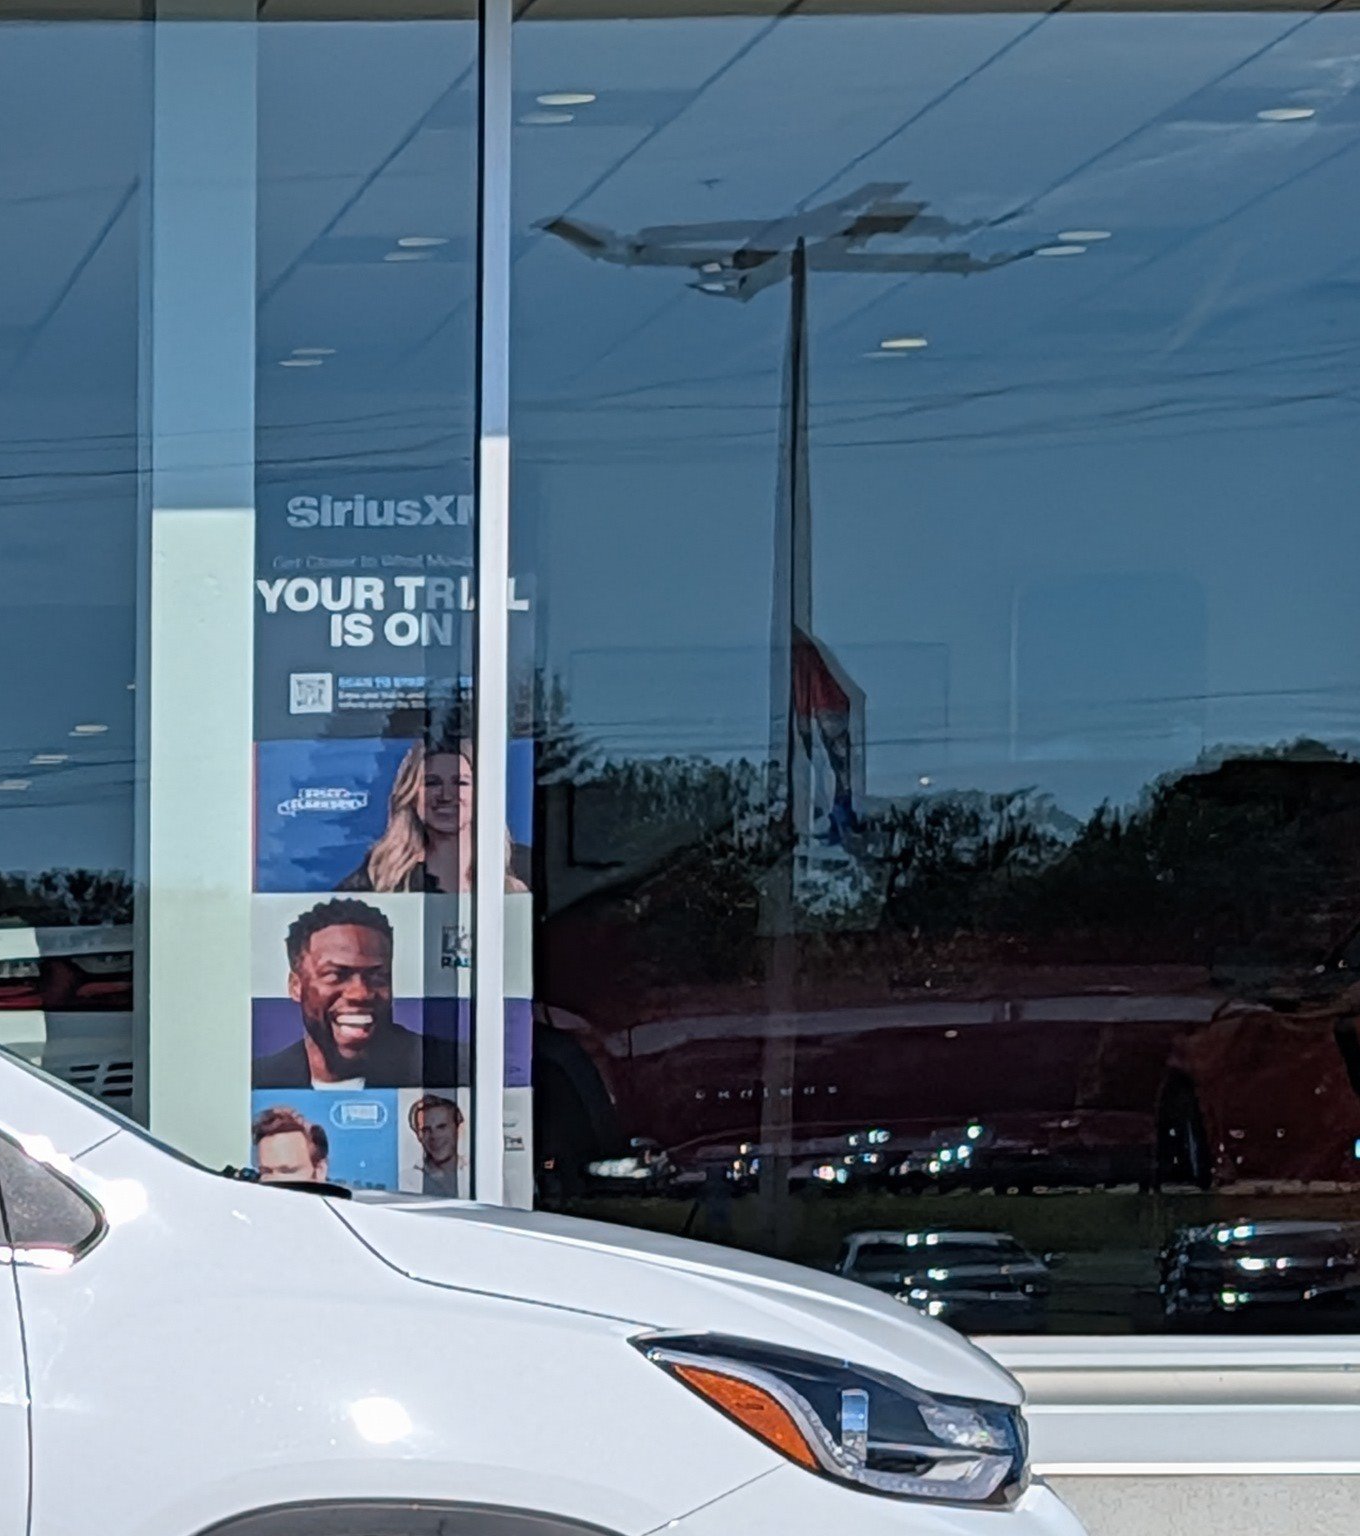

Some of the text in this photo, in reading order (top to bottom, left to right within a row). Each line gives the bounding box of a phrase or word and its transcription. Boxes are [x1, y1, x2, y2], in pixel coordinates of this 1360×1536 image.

[257, 576, 530, 613] YOUR TRIL
[330, 612, 453, 647] IS ON
